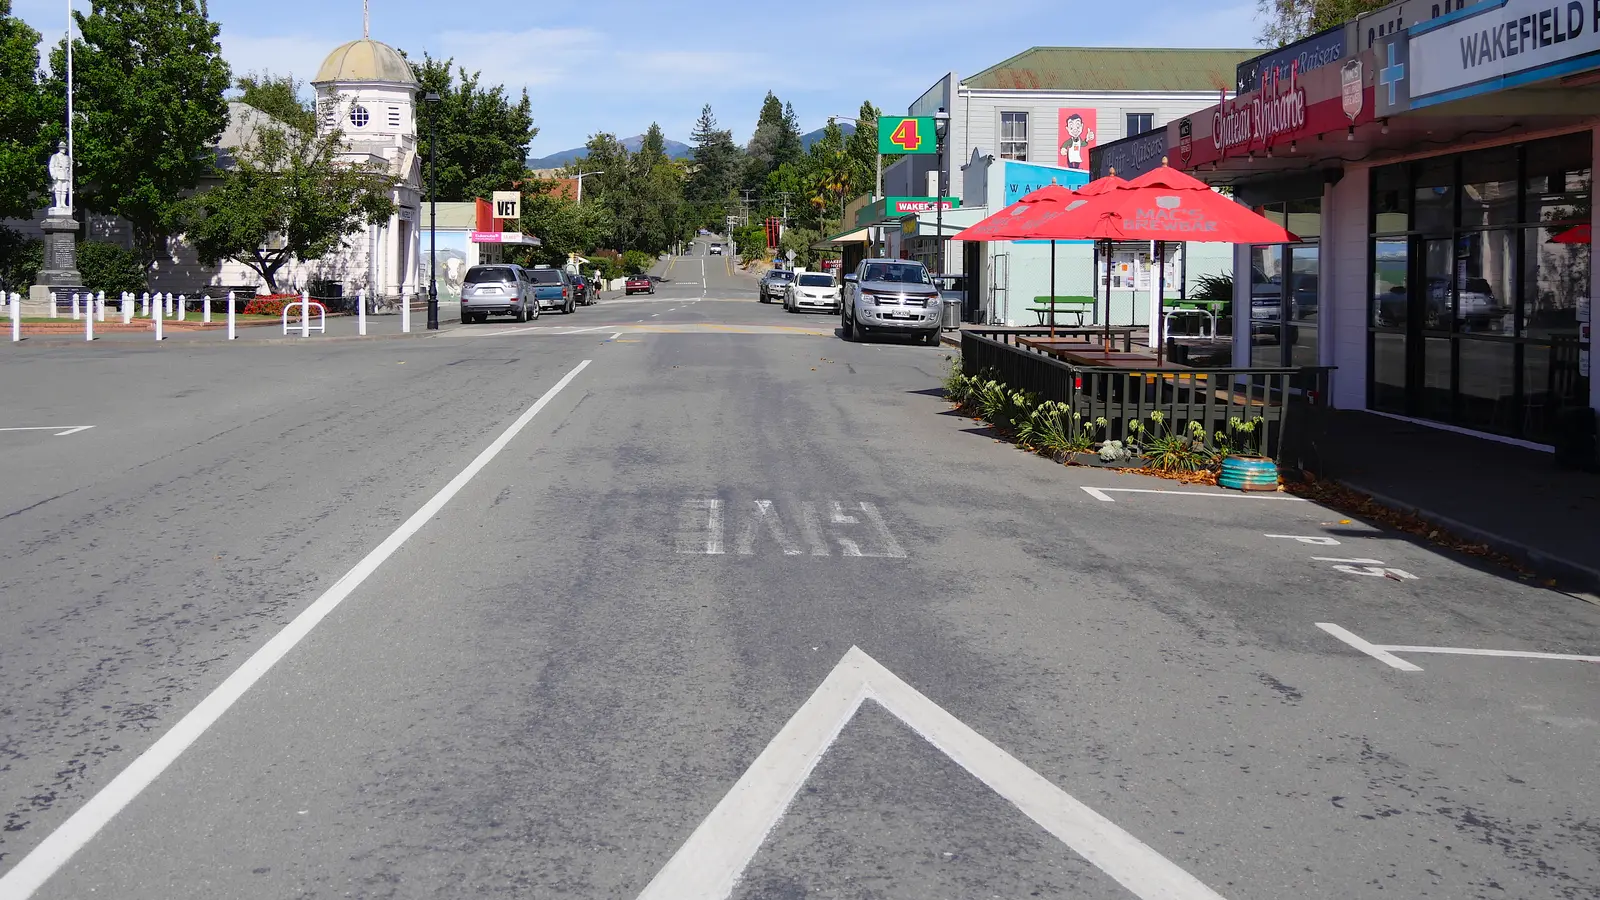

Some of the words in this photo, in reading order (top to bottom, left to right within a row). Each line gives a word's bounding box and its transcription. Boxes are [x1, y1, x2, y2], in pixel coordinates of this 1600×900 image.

[1459, 0, 1584, 70] WAKEFIELD
[1298, 42, 1341, 76] Raisers
[890, 119, 921, 151] 4
[1131, 137, 1163, 171] Raisers
[497, 201, 516, 216] VET
[899, 203, 949, 211] WAKEFED
[1136, 208, 1204, 220] MAC'S
[1123, 219, 1218, 232] BREWBAR
